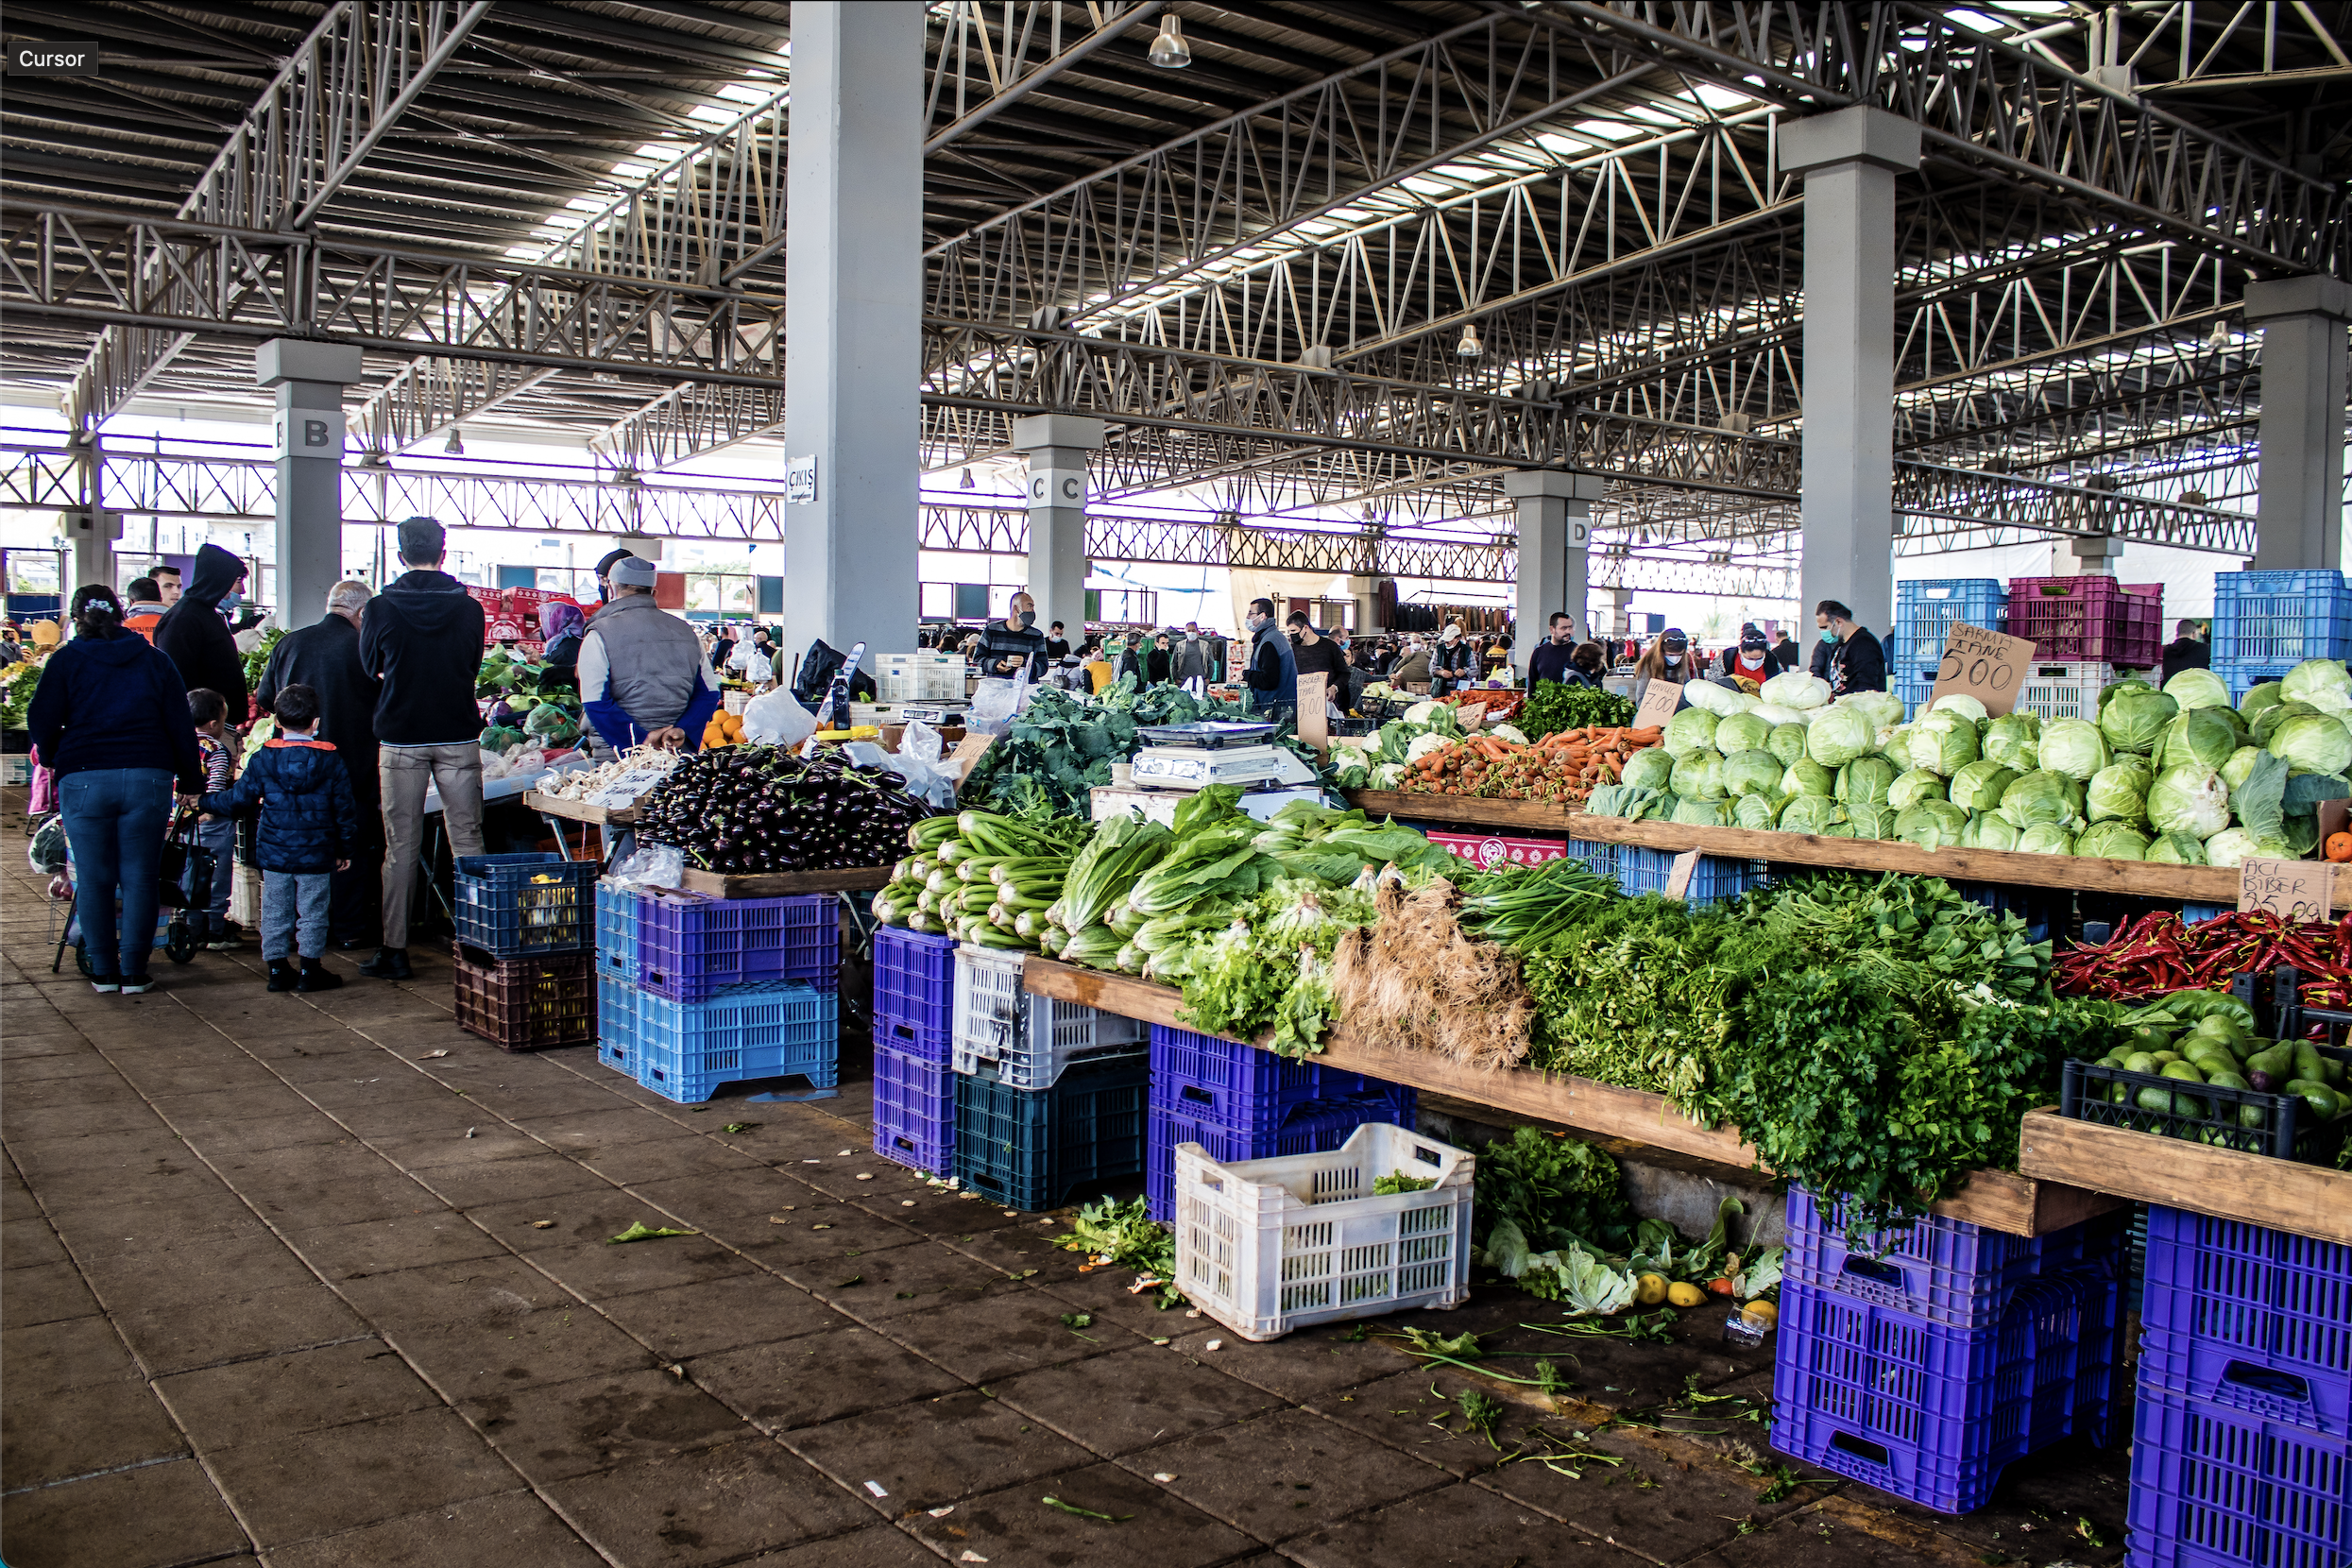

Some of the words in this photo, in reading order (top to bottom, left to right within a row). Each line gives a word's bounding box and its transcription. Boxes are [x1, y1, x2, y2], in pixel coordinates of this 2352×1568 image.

[305, 419, 329, 447] B
[789, 469, 813, 490] ÇIKIŞ
[1033, 478, 1044, 499] C
[1063, 478, 1078, 499] C
[1575, 523, 1586, 541] D
[1951, 623, 2015, 648] SARMA
[1951, 639, 2009, 661] TANE
[1298, 696, 1322, 722] 5.00
[1643, 692, 1674, 713] 7.00
